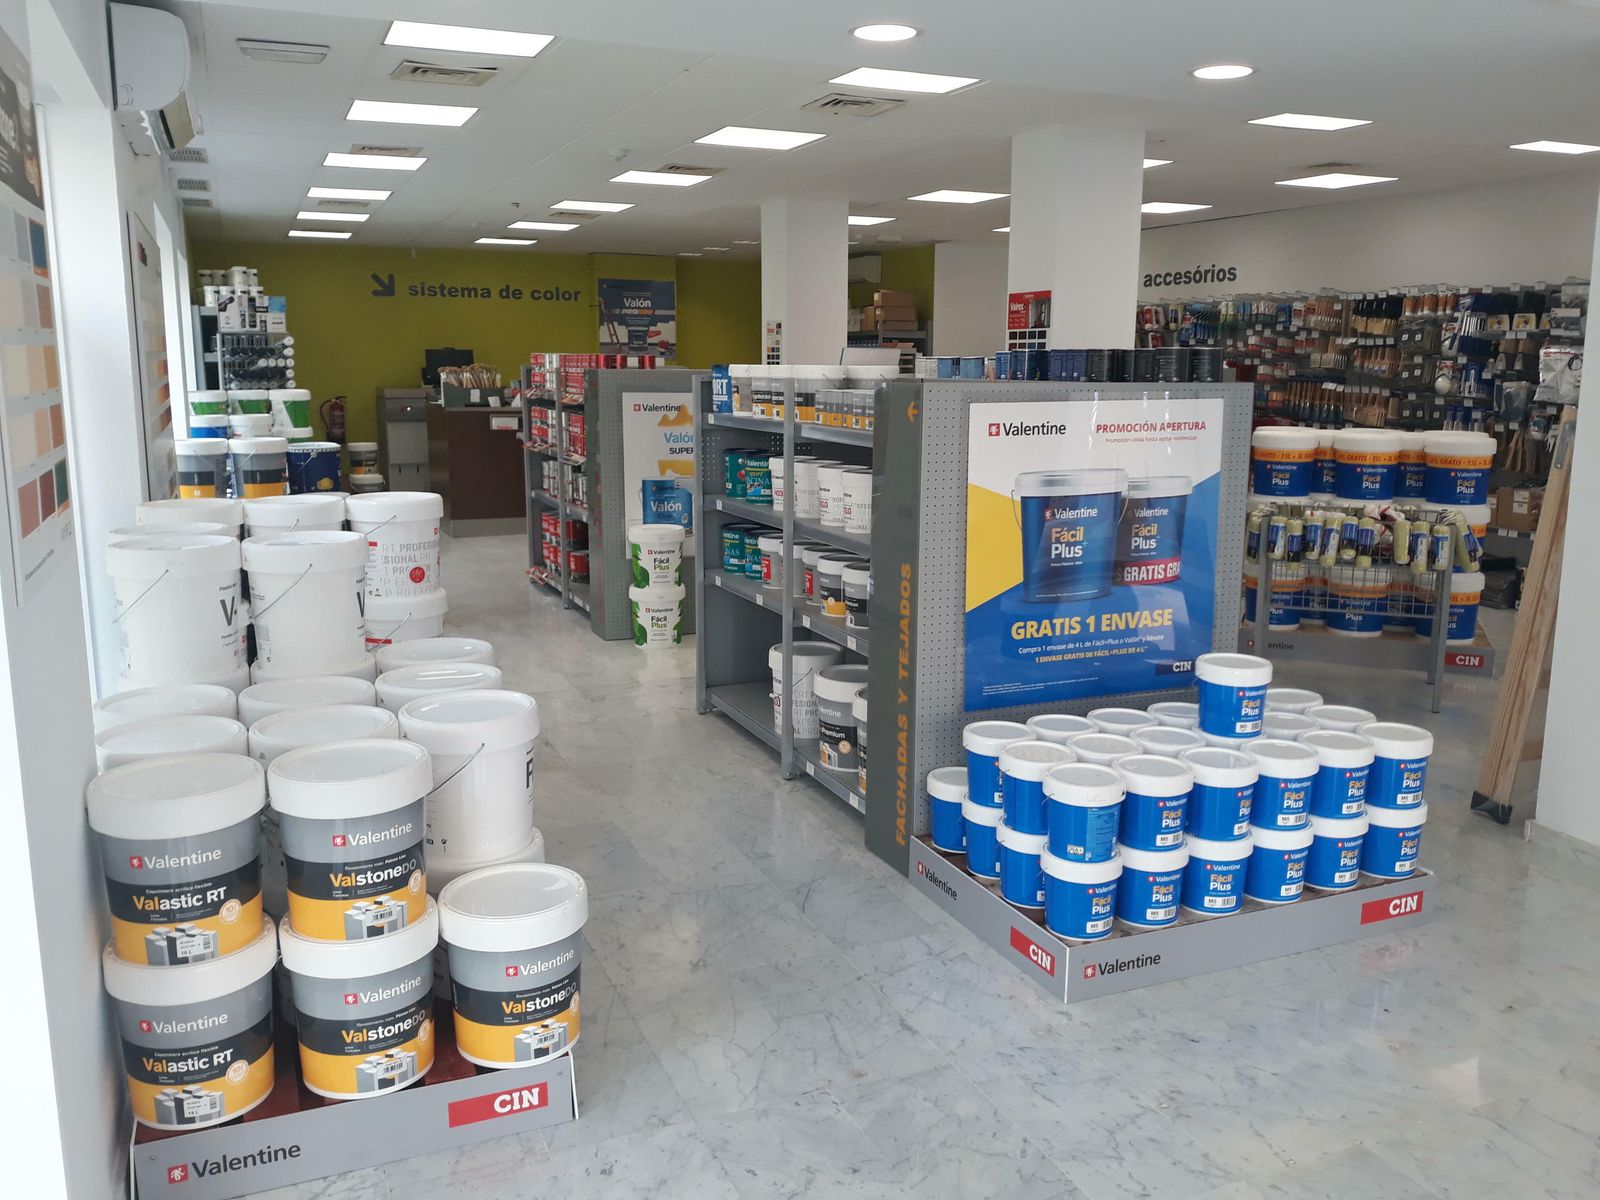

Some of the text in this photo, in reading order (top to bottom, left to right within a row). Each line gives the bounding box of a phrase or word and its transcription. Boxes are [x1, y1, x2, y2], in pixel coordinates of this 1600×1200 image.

[1143, 264, 1237, 288] accesórios
[408, 282, 581, 302] sistema de color
[623, 297, 651, 308] Valón
[642, 403, 681, 412] Valentine
[1003, 421, 1067, 437] Valentine
[1096, 420, 1207, 434] PROMOCIÓN APERTURA
[1272, 478, 1289, 486] Plus
[1362, 481, 1380, 489] Plus
[1456, 486, 1475, 494] Plus
[651, 500, 682, 512] Valón
[1054, 506, 1098, 519] Valentine
[1134, 507, 1169, 518] Valentine
[1051, 527, 1084, 543] Fácil
[1131, 523, 1158, 537] Fácil
[1131, 536, 1157, 550] Plus
[1051, 543, 1083, 559] Plus
[1124, 564, 1165, 582] GRATIS
[1345, 613, 1363, 621] Plus
[1011, 608, 1173, 641] GRATIS 1 ENVASE
[1018, 646, 1042, 655] Compra
[1267, 642, 1295, 651] entine
[1039, 655, 1063, 663] ENVASE
[1455, 655, 1480, 666] CIN
[1172, 660, 1192, 672] CIN
[895, 563, 911, 847] FACHADAS Y TEJADOS
[1241, 707, 1260, 716] Plus
[821, 726, 846, 739] Premium
[1402, 779, 1421, 788] Plus
[1348, 788, 1364, 797] Plus
[1283, 799, 1303, 809] Plus
[1162, 817, 1181, 828] Plus
[348, 822, 412, 847] Valentine
[1401, 847, 1417, 856] Plus
[143, 849, 221, 870] Valentine
[1340, 857, 1358, 866] Plus
[1286, 870, 1303, 879] Plus
[923, 865, 958, 902] Valentine
[1209, 881, 1231, 891] Plus
[132, 886, 227, 911] Valastic RT
[1152, 892, 1173, 903] Plus
[1091, 904, 1110, 915] Plus
[1388, 895, 1418, 915] CIN
[519, 949, 575, 976] Valentine
[1029, 944, 1051, 972] CIN
[1098, 952, 1161, 976] Valentine
[360, 976, 421, 1004] Valentine
[152, 1013, 228, 1034] Valentine
[142, 1057, 210, 1074] Valastic
[212, 1048, 234, 1066] RT
[493, 1084, 539, 1114] CIN
[191, 1142, 302, 1179] Valentine
